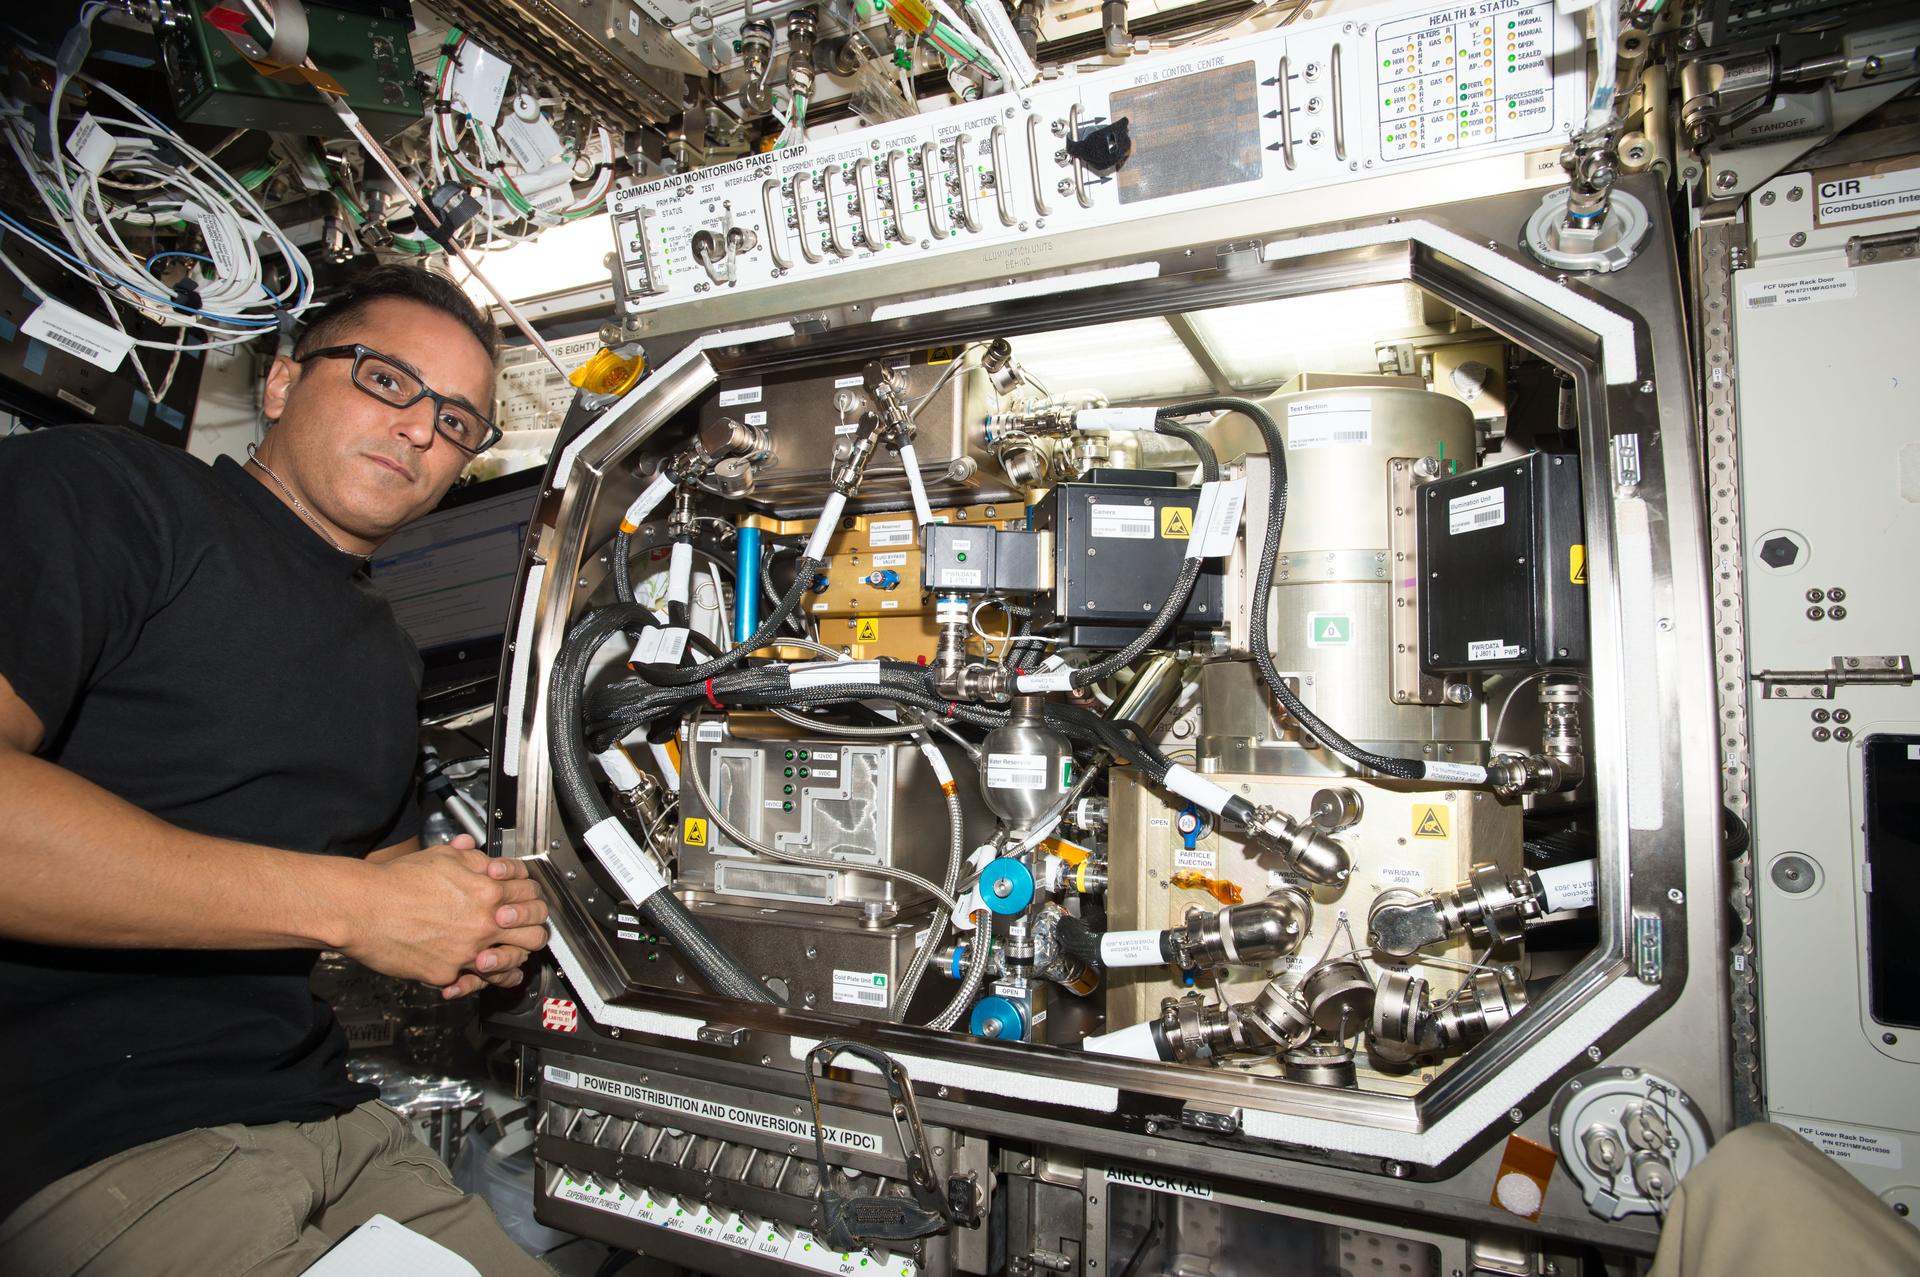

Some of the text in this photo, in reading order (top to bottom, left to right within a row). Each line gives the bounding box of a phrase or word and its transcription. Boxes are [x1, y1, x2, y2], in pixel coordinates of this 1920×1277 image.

[1429, 0, 1520, 26] HEALTH & STATUS
[1417, 30, 1440, 39] FILTERS
[1518, 28, 1542, 38] MANUAL
[1429, 39, 1441, 47] GAS
[1518, 40, 1534, 49] OPEN
[1518, 49, 1541, 60] SEALED
[1134, 56, 1225, 84] INFO & CONTROL CENTRE
[1430, 78, 1443, 86] GAS
[1393, 86, 1406, 94] GAS
[1505, 88, 1544, 102] PROCESSORS
[938, 116, 998, 137] SPECIAL FUNCTIONS
[1751, 118, 1806, 135] STANDOFF
[886, 135, 916, 149] FUNCTIONS
[782, 148, 863, 174] EXPERIMENT POWER OUTLETS
[1538, 162, 1554, 170] LOCK
[616, 145, 808, 201] COMMAND AND MONITORING PANEL (CMP)
[702, 174, 757, 193] TEST INTERFACES
[1821, 180, 1860, 198] CIR
[656, 199, 668, 207] PRIM
[1821, 198, 1895, 216] (Combustion
[662, 208, 683, 217] STATUS
[983, 241, 1053, 261] ILLUMINATION UNITS
[1005, 257, 1031, 269] BEHIND
[1778, 281, 1798, 289] Upper
[565, 341, 597, 354] EIGHTY
[1304, 403, 1328, 411] Section
[1451, 499, 1480, 510] Illumination
[1471, 643, 1500, 651] PWR/DATA
[1180, 851, 1211, 860] PARTICLE
[1178, 859, 1213, 867] INJECTION
[1383, 868, 1420, 877] PWR/DATA
[1285, 957, 1303, 965] DATA
[1390, 966, 1409, 974] DATA
[1002, 988, 1019, 996] OPEN
[584, 1076, 622, 1095] POWER
[624, 1086, 699, 1112] DISTRIBUTION
[701, 1103, 725, 1118] AND
[728, 1109, 807, 1136] CONVERSION
[840, 1131, 876, 1150] (PDC)
[1799, 1127, 1878, 1144] FCF Lower Rack Door
[1106, 1166, 1213, 1197] AIRLOCK (AL)
[565, 1189, 622, 1211] EXPERIMENT POWERS
[637, 1209, 649, 1219] FAN
[667, 1217, 684, 1228] FAN C
[695, 1225, 714, 1236] FAN R
[722, 1232, 748, 1246] AIRLOCK
[839, 1263, 854, 1274] CMP
